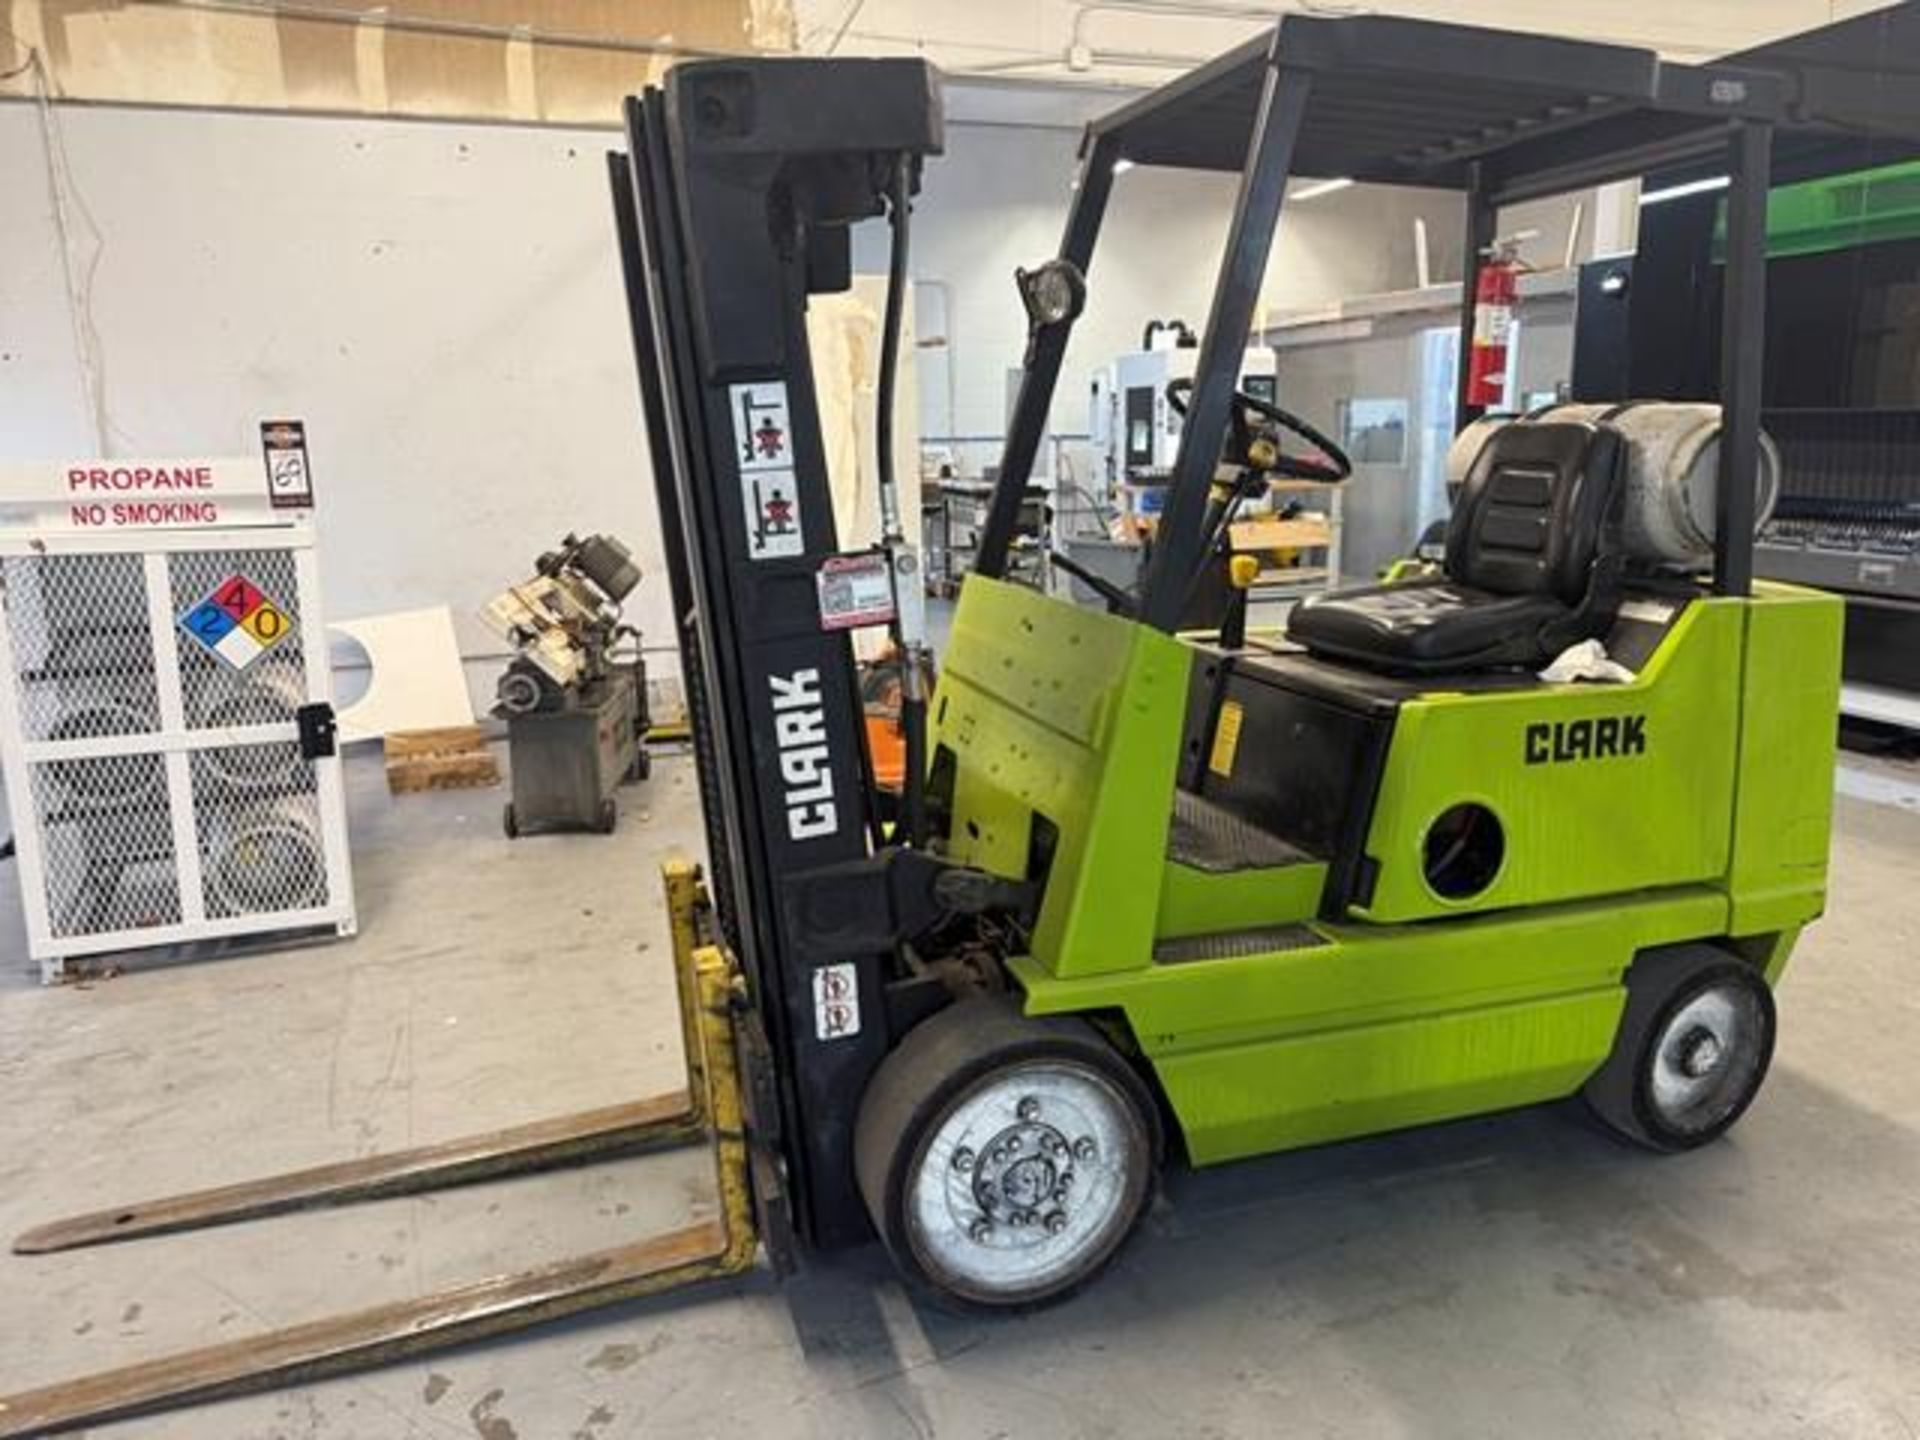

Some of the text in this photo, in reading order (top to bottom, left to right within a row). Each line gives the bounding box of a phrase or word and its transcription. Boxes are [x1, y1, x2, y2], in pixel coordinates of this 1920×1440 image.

[68, 467, 213, 490] PROPANE
[71, 503, 217, 526] NO SMOKING
[223, 583, 248, 616] 4
[200, 607, 280, 639] 2 0
[768, 668, 838, 840] CLARK
[1524, 714, 1646, 765] CLARK
